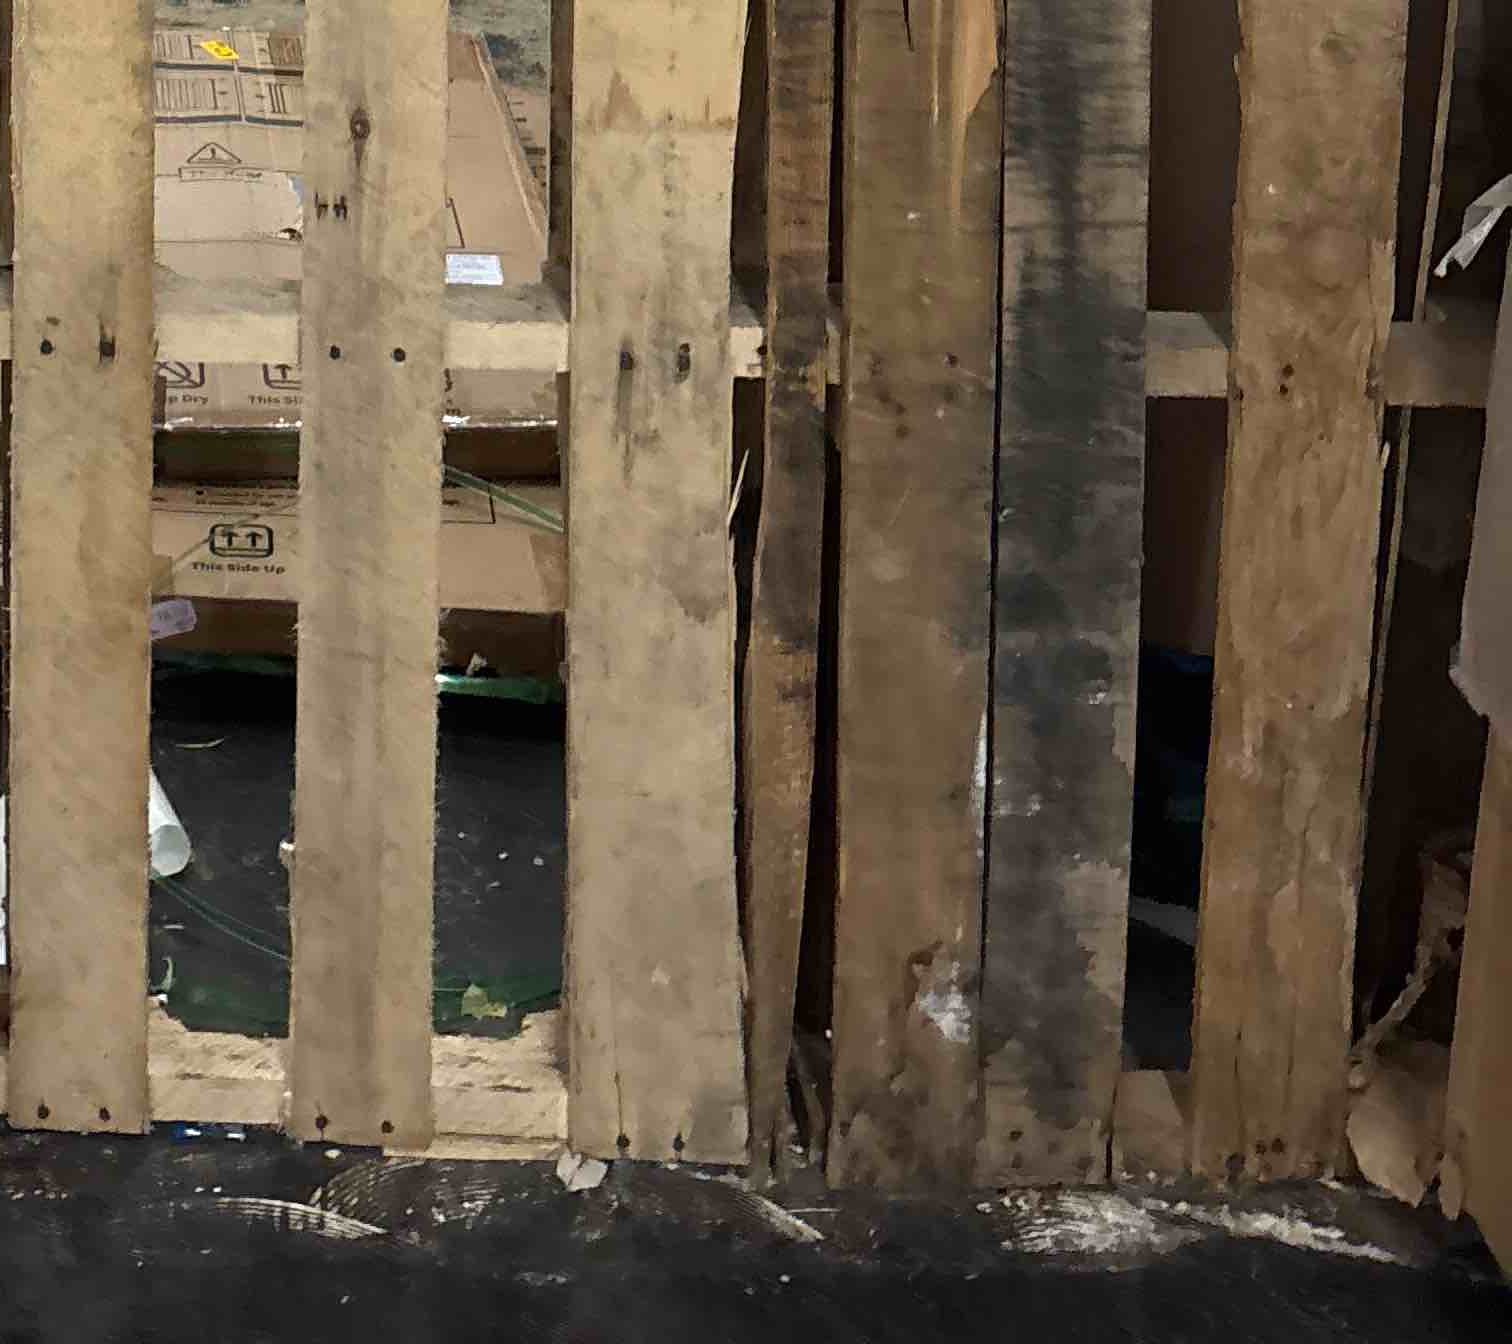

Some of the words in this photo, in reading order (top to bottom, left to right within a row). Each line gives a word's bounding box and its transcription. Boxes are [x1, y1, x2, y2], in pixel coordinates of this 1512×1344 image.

[192, 561, 223, 572] This
[227, 563, 260, 573] Side
[264, 565, 285, 575] Up
